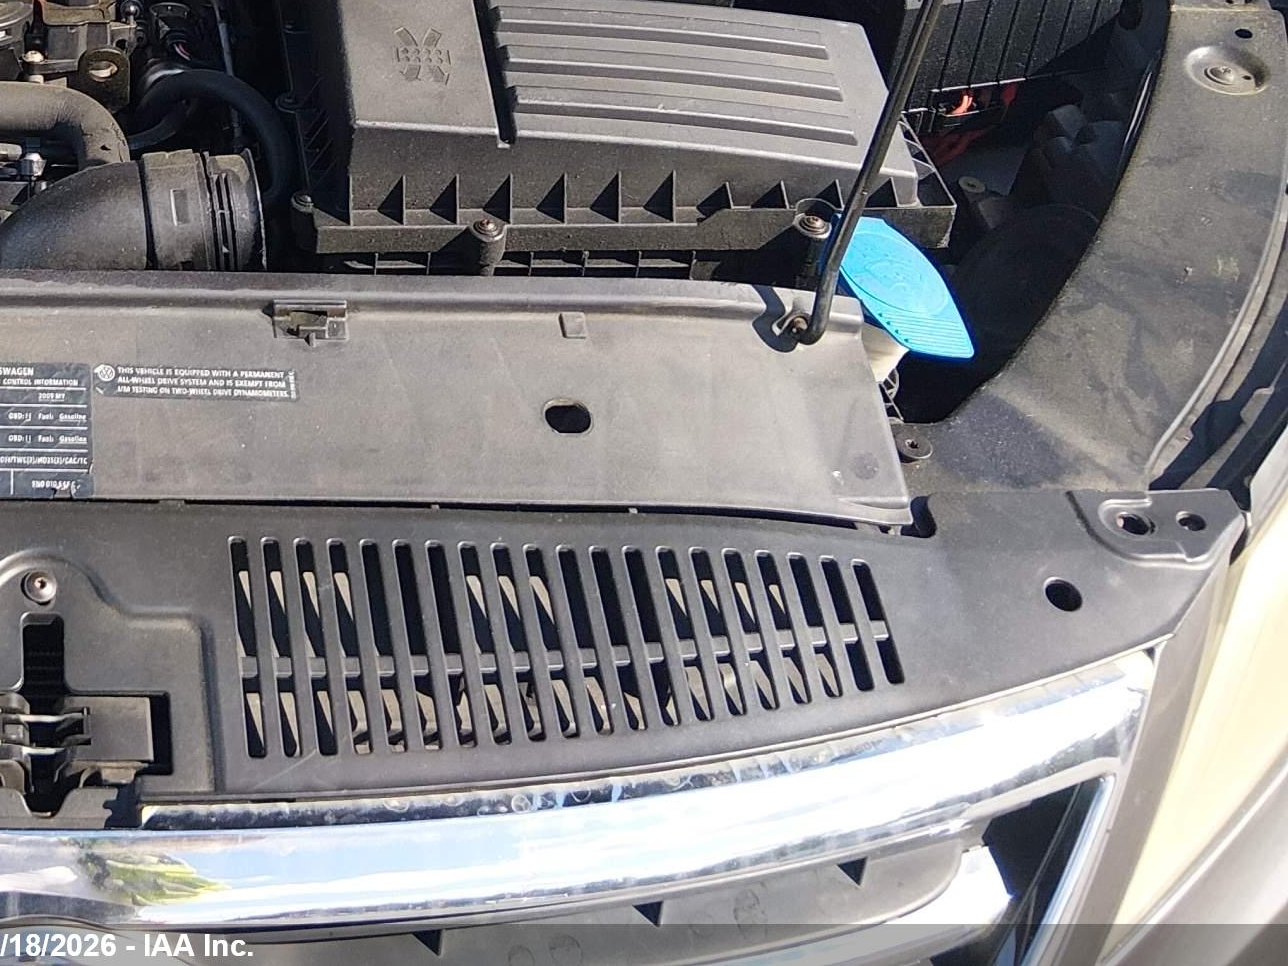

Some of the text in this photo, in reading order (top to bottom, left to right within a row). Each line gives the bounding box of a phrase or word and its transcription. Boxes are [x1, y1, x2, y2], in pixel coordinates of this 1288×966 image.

[117, 366, 134, 375] THIS
[136, 367, 164, 375] VEHICLE
[166, 367, 172, 375] IS
[174, 368, 210, 376] EQUIPPED
[212, 369, 231, 377] WITH
[240, 370, 284, 379] PERMANENT
[3, 378, 32, 386] CONTROL
[117, 376, 155, 384] ALL-WHEEL
[158, 377, 178, 385] DRIVE
[179, 378, 207, 386] SYSTEM
[264, 380, 286, 388] FROM
[132, 386, 158, 394] TESTING
[172, 387, 211, 395] TWO-WHEEL
[213, 388, 232, 396] DRIVE
[59, 413, 87, 421] Gasoline
[59, 435, 87, 443] Gasoline
